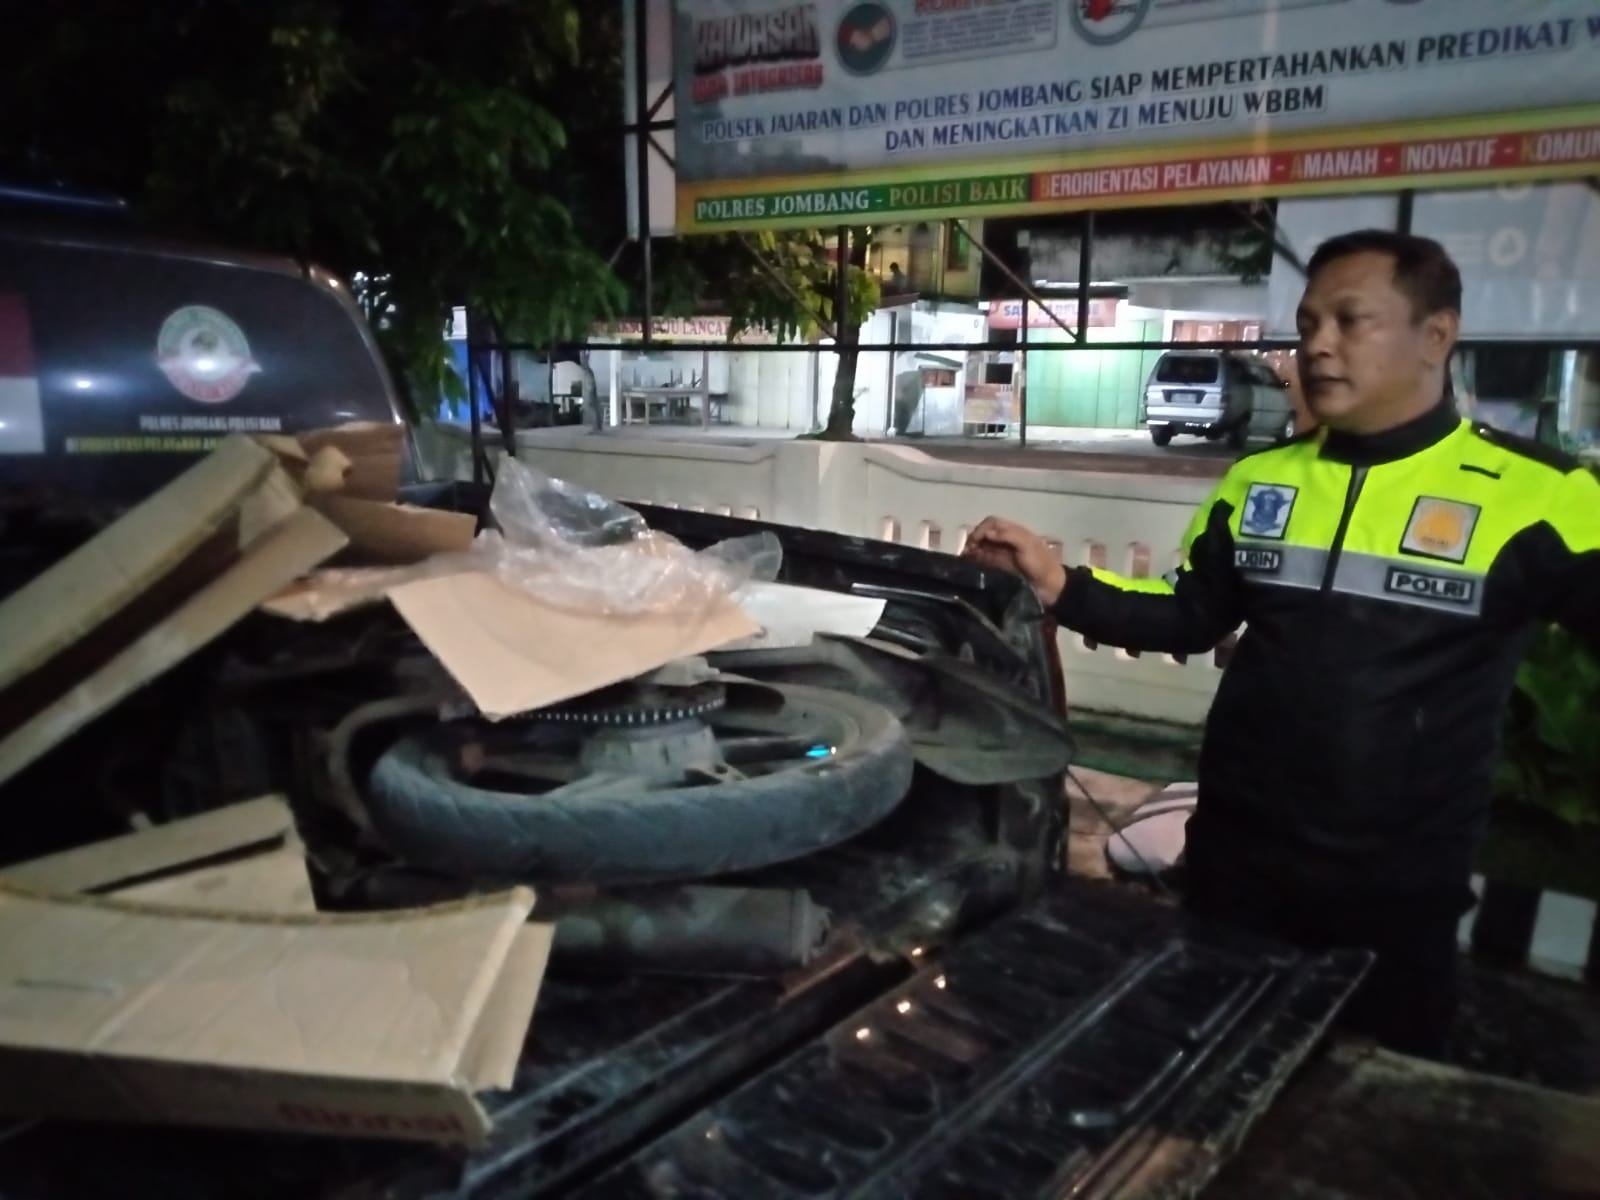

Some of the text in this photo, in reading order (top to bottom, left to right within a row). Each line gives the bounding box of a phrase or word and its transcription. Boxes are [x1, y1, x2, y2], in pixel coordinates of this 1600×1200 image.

[704, 116, 765, 141] POLSEK
[770, 107, 842, 134] JAJARAN
[849, 102, 887, 126] DAN
[895, 92, 969, 121] POLRES
[977, 79, 1082, 112] JOMBANG
[1091, 73, 1143, 100] SIAP
[1152, 39, 1406, 93] MEMPERTAHANKAN
[1417, 17, 1575, 63] PREDIKAT
[886, 84, 1324, 151] DAN MENINGKATKAN ZI MENUJU WBBM
[1163, 156, 1271, 191] PELAYANAN
[696, 197, 765, 220] POLRES
[770, 189, 869, 216] JOMBANG
[889, 181, 961, 208] POLISI
[969, 177, 1026, 202] BAIK
[1395, 574, 1466, 599] POLRI
